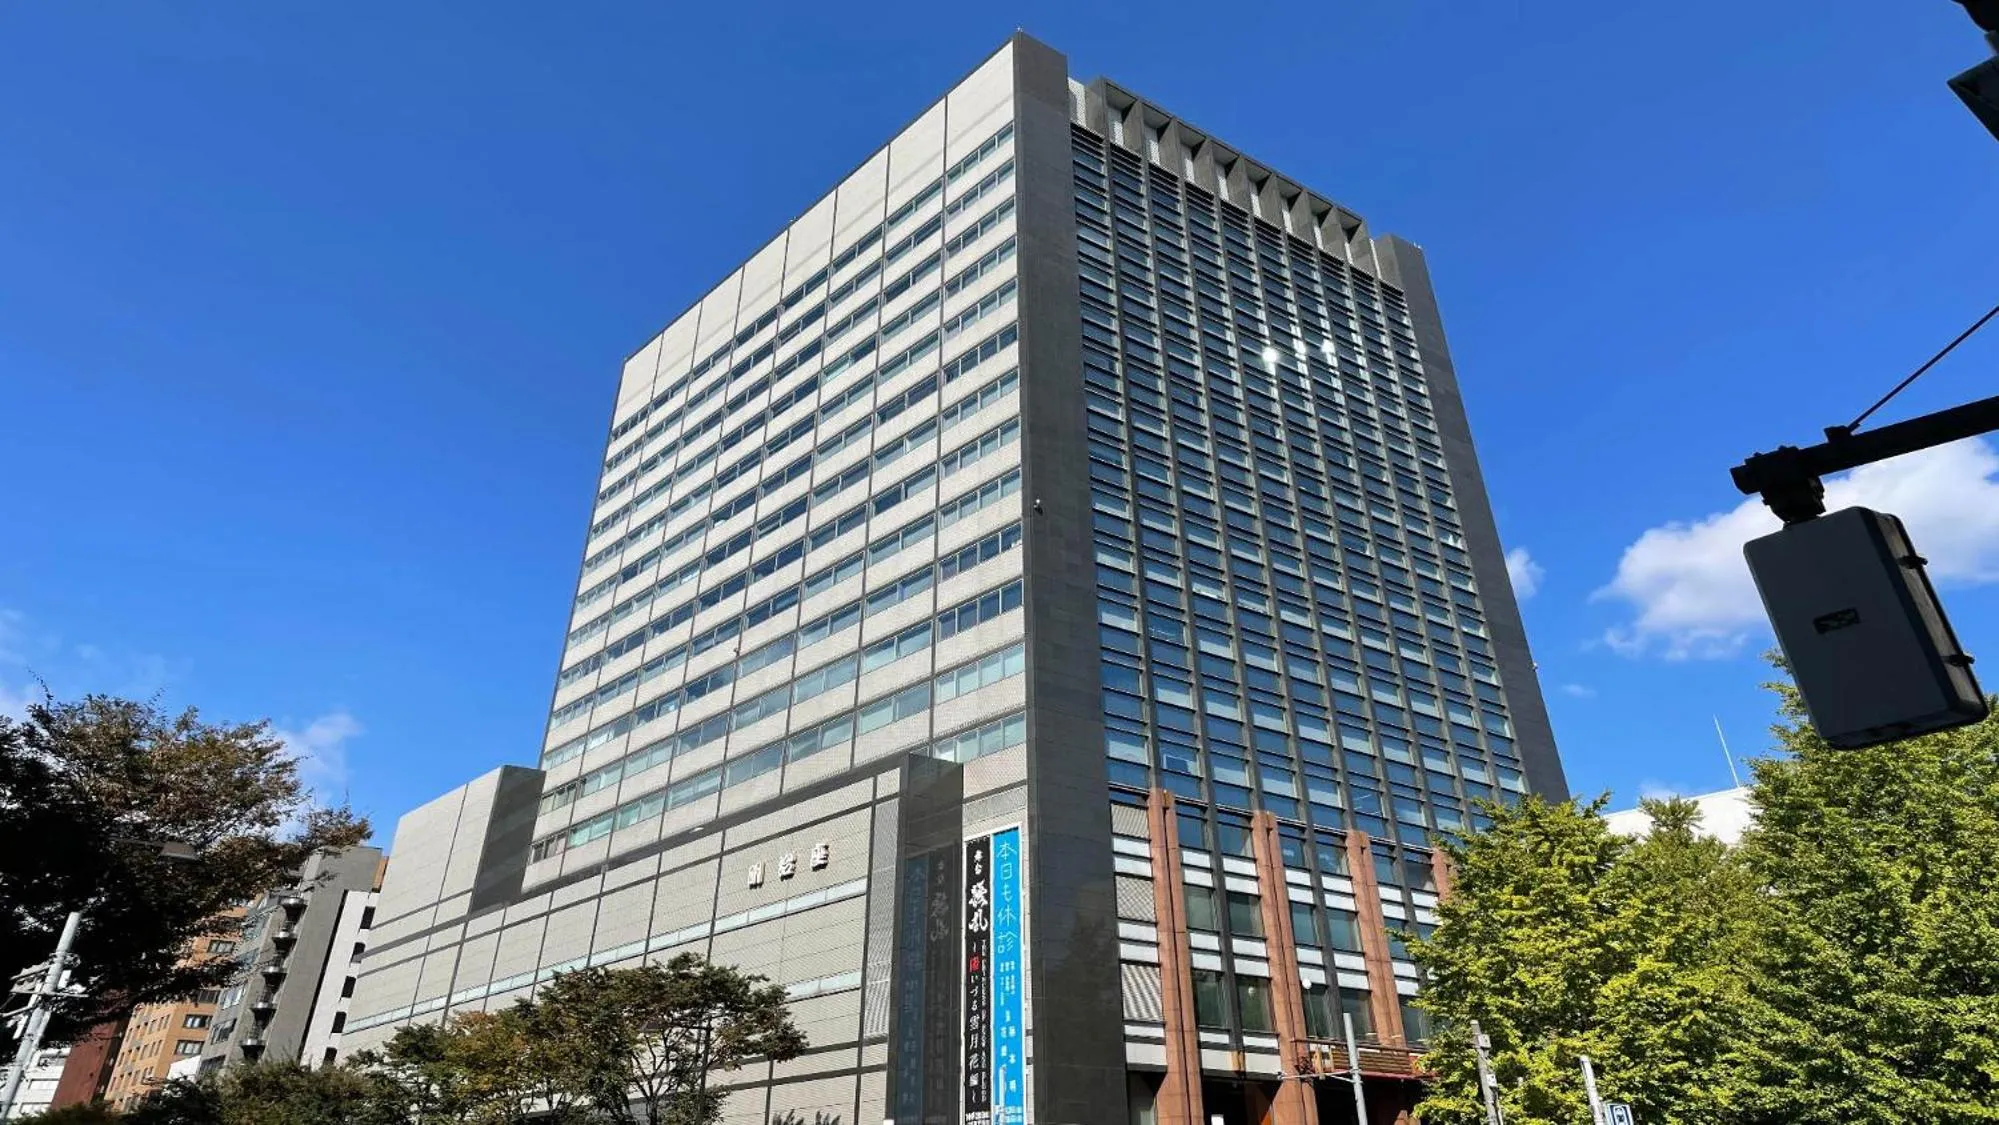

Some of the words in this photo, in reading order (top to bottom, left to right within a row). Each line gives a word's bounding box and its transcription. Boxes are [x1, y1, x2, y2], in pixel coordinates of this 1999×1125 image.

[996, 840, 1018, 954] 本日も休診
